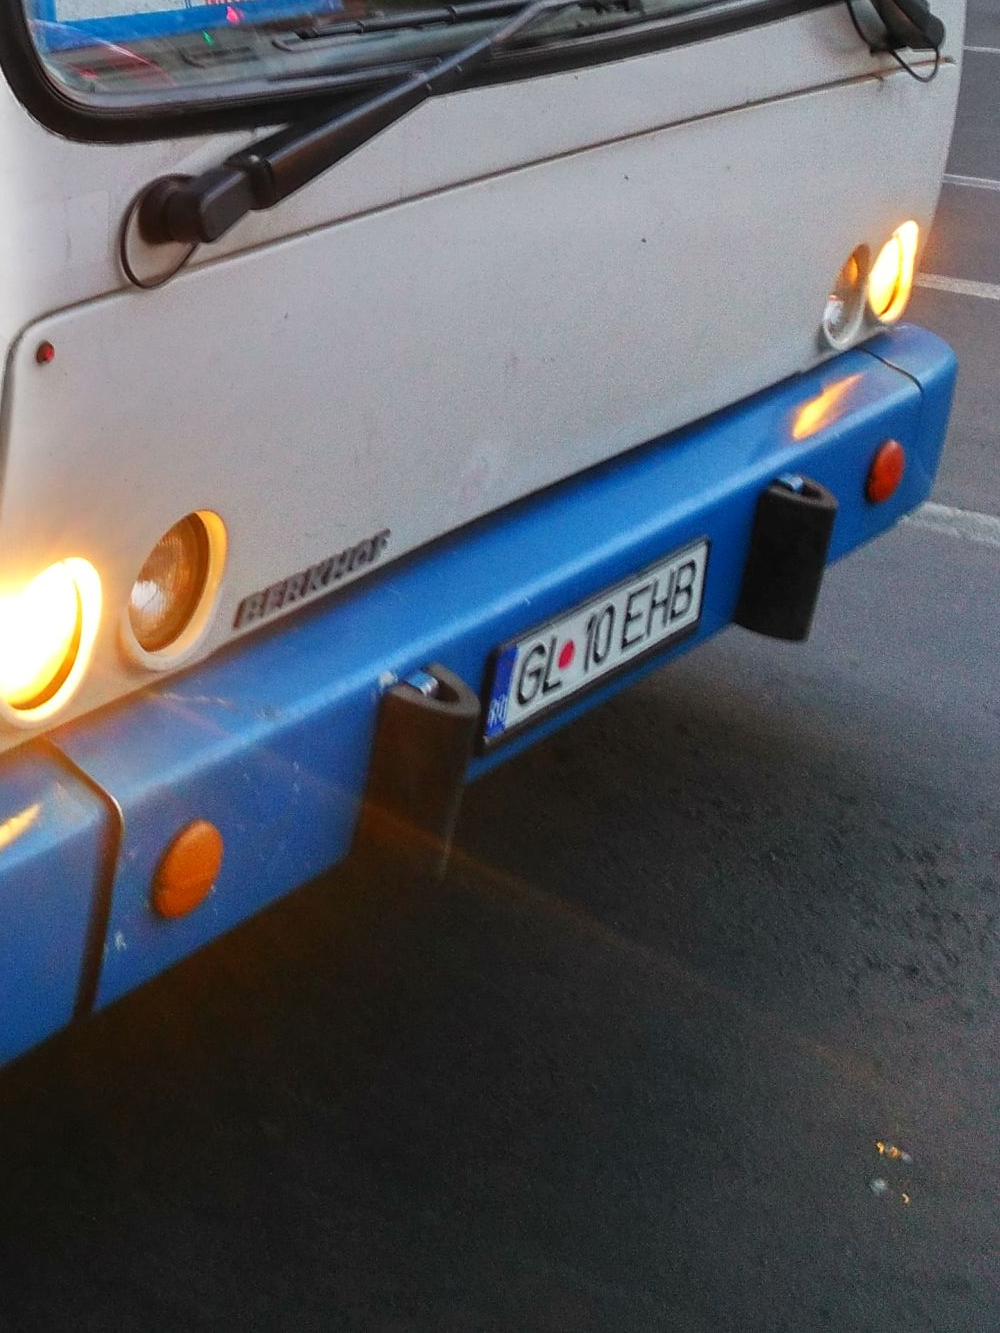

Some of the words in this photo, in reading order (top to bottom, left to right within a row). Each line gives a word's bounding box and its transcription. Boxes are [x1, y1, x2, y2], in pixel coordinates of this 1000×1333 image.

[516, 635, 562, 705] GL
[584, 603, 616, 672] 10
[621, 559, 698, 650] EHB
